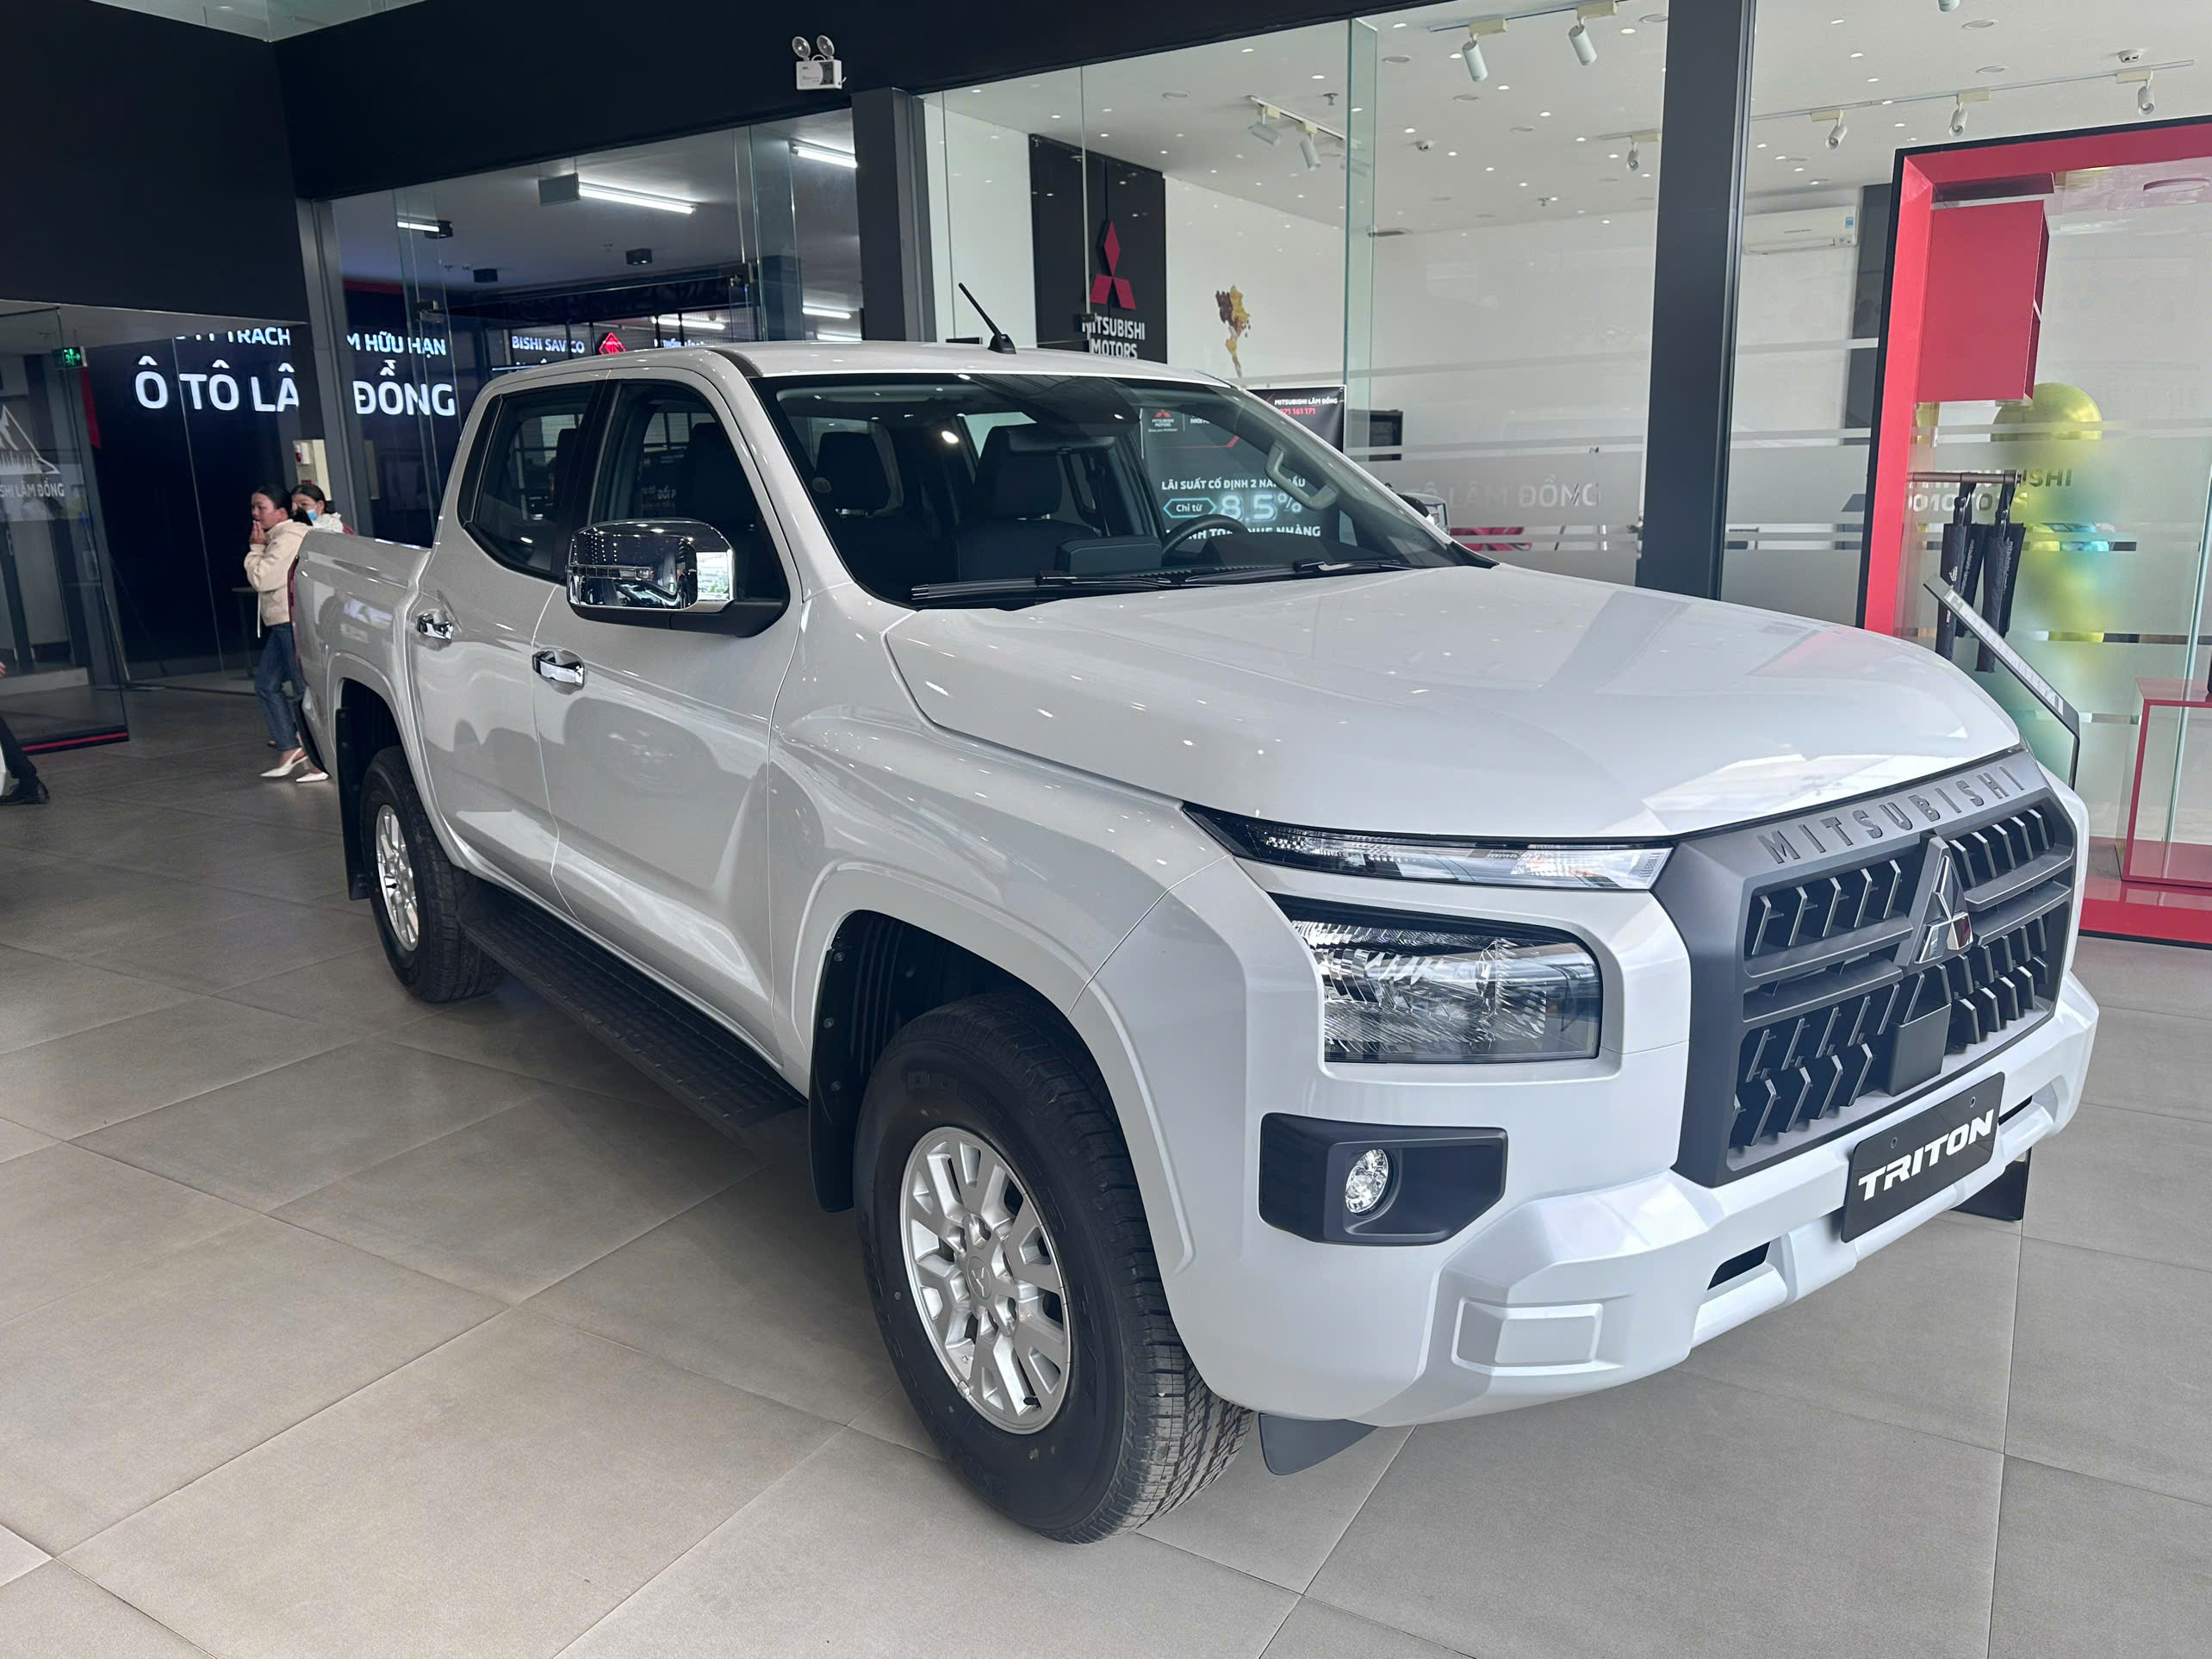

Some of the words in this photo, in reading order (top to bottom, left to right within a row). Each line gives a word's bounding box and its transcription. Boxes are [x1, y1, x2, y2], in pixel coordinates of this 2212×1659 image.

[364, 331, 404, 353] HỮU
[407, 337, 447, 358] HẠN
[544, 337, 585, 354] SAVCO
[1090, 338, 1138, 359] MOTORS
[134, 355, 169, 409] Ô
[178, 358, 239, 411] TÔ
[250, 362, 300, 413] LÂ
[1250, 479, 1257, 488] 2
[1756, 766, 2025, 865] MITSUBISHI
[1858, 1109, 1994, 1202] TRITON
